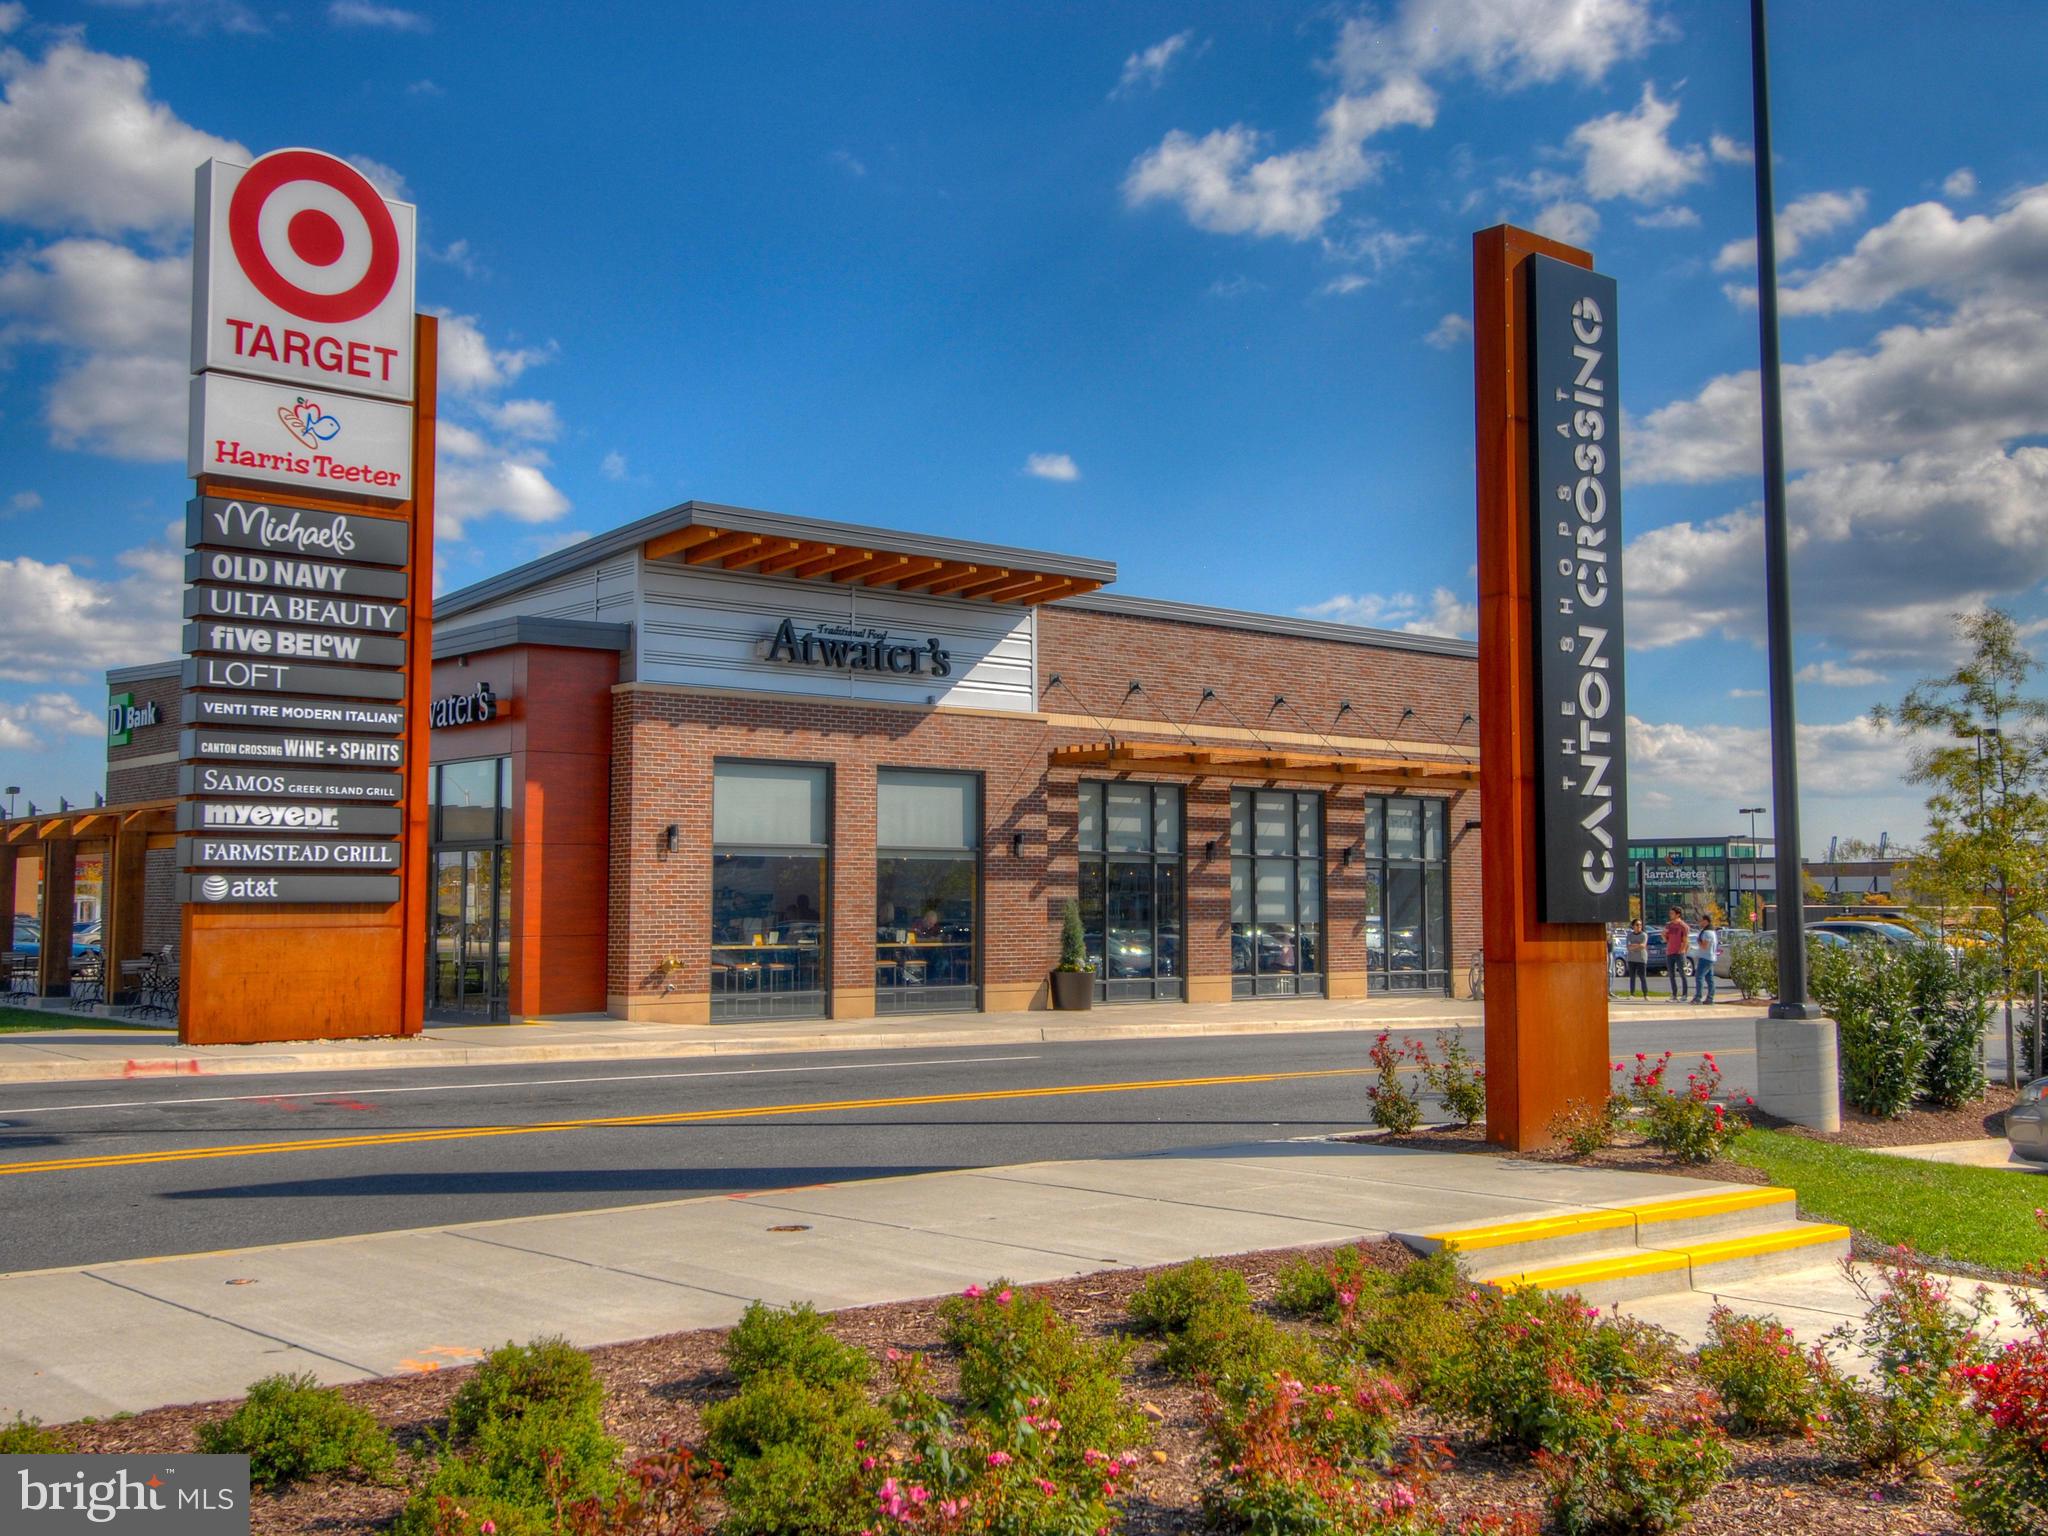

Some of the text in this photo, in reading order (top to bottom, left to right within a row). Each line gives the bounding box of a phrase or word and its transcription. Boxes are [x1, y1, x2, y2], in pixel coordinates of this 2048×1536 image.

[225, 318, 398, 381] TARGET
[215, 440, 401, 488] Harris Teeter
[213, 501, 356, 556] Michaels
[212, 554, 347, 592] OLD NAVY
[1555, 387, 1577, 791] THE SHOPS AT
[210, 589, 398, 629] ULTA BEAUTY
[1572, 296, 1615, 895] CANTON CROSSING
[210, 625, 272, 653] five
[764, 617, 951, 678] Atwater's
[208, 660, 290, 689] LOFT
[126, 702, 157, 730] Bank
[203, 702, 247, 716] VENTI
[251, 704, 279, 717] TRE
[282, 706, 342, 721] MODERN
[201, 742, 237, 754] CANTON
[238, 744, 283, 756] CROSSING
[284, 739, 325, 758] WINE
[340, 742, 400, 762] SPIRITS
[203, 769, 395, 797] SAMOS GREEK ISLAND GRILL
[203, 843, 392, 864] FARMSTEAD GRILL
[231, 877, 279, 898] at&t
